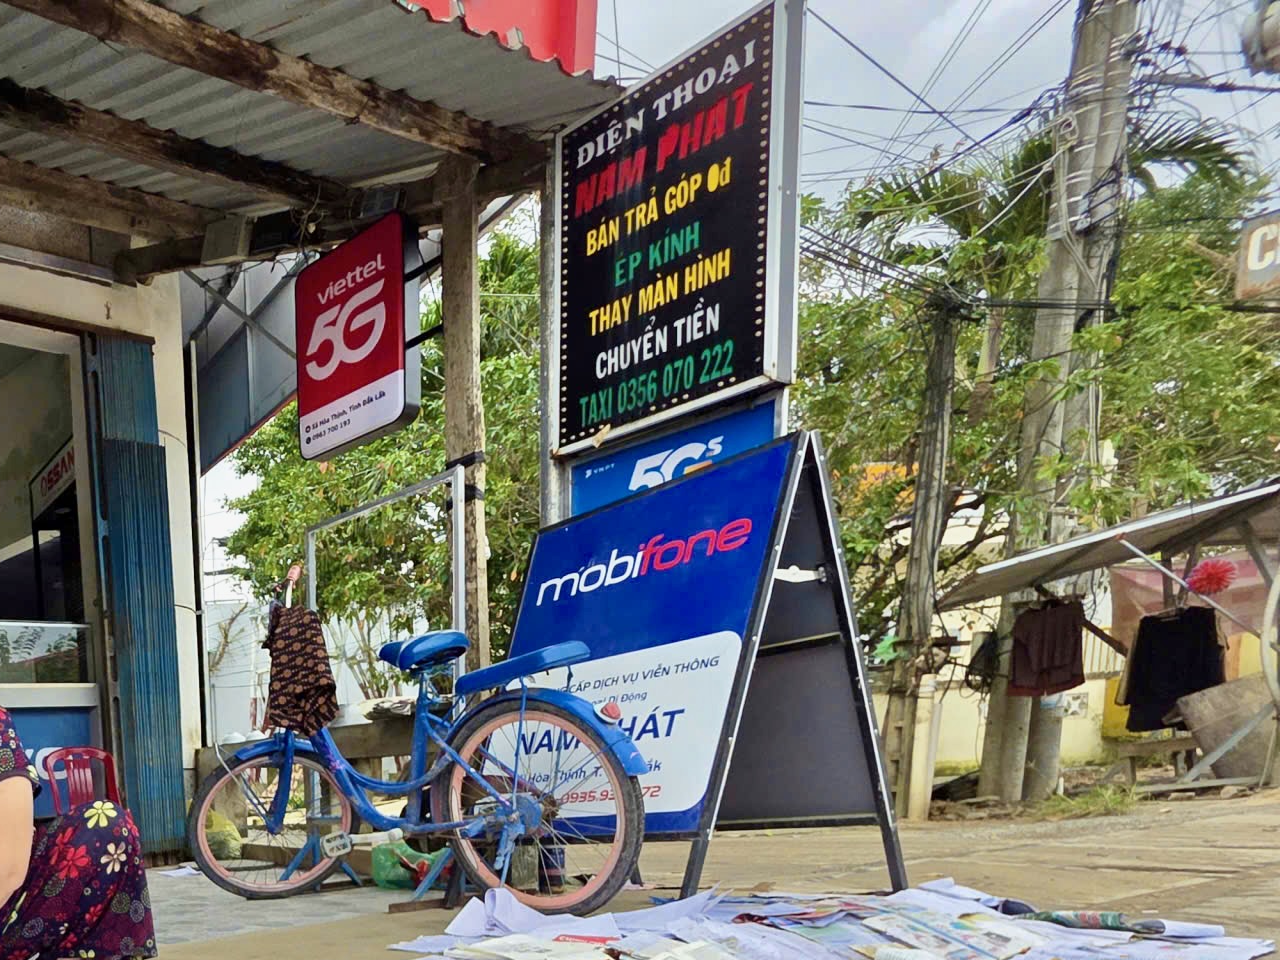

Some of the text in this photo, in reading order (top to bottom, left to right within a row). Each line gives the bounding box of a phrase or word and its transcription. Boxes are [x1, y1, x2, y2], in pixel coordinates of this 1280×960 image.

[577, 39, 756, 169] ĐIỆN THOẠI
[575, 146, 648, 218] NAM
[586, 215, 620, 257] BÁN
[624, 186, 659, 236] TRẢ
[664, 172, 703, 216] GÓP
[317, 252, 386, 306] viettel
[588, 247, 732, 337] THAY MÀN HÌNH
[614, 221, 701, 288] ÉP KÍNH
[304, 277, 387, 381] 5G
[595, 297, 721, 380] CHUYỂN TIỀN
[579, 339, 735, 428] TAXI 0356 070 222
[536, 518, 753, 606] mobifone
[592, 675, 620, 691] DỊCH
[622, 673, 639, 685] VỤ
[642, 663, 671, 680] VIỄN
[674, 655, 720, 674] THÔNG
[620, 692, 648, 705] Động
[617, 706, 686, 742] HÁT
